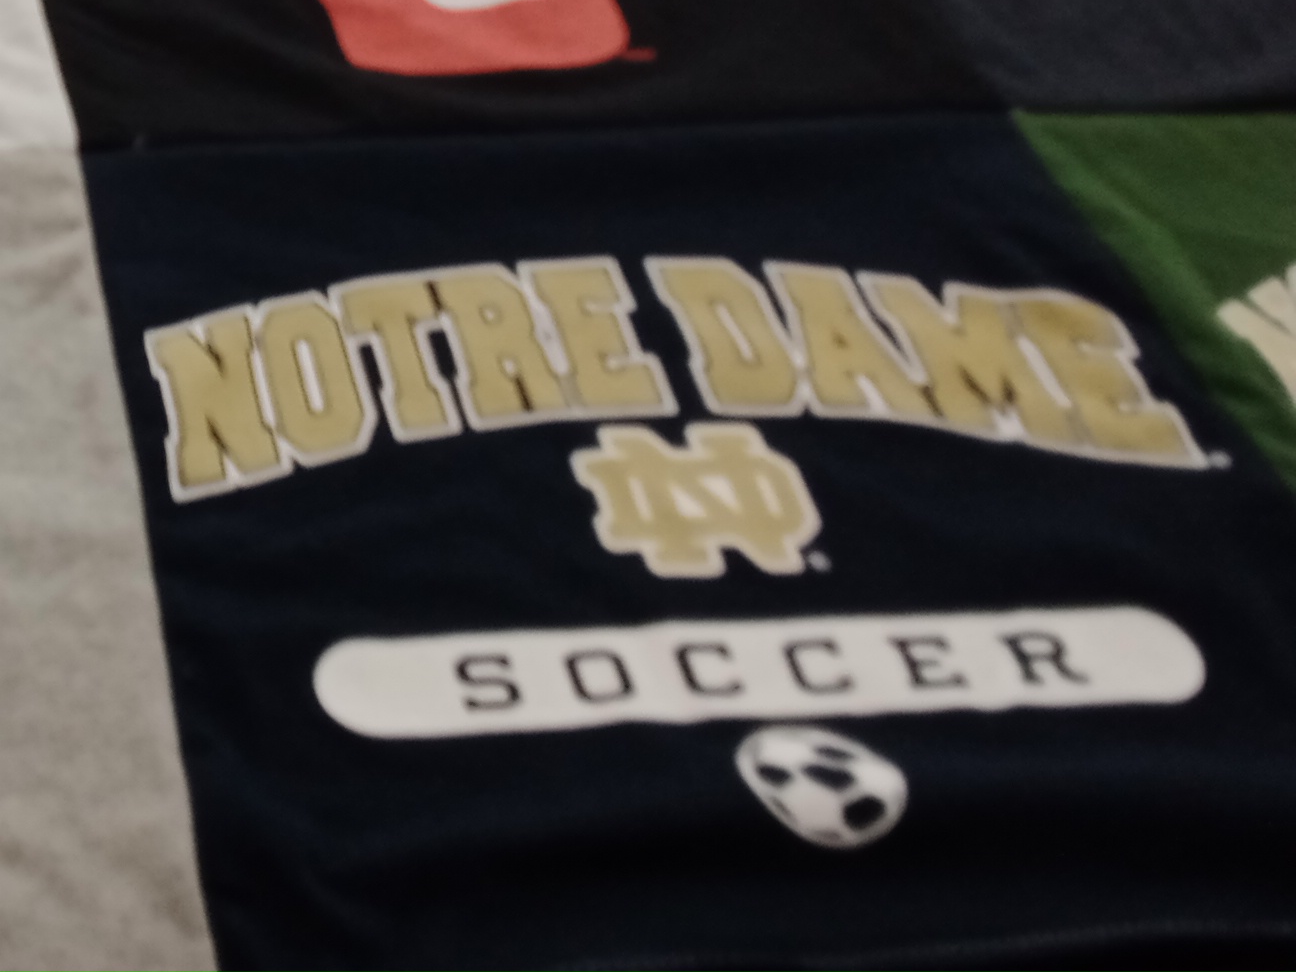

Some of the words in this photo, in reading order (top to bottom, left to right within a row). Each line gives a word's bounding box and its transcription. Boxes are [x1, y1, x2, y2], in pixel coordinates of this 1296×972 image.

[143, 256, 679, 503] NOTRE
[644, 254, 1210, 470] DAME
[453, 631, 1092, 715] SOCCER
